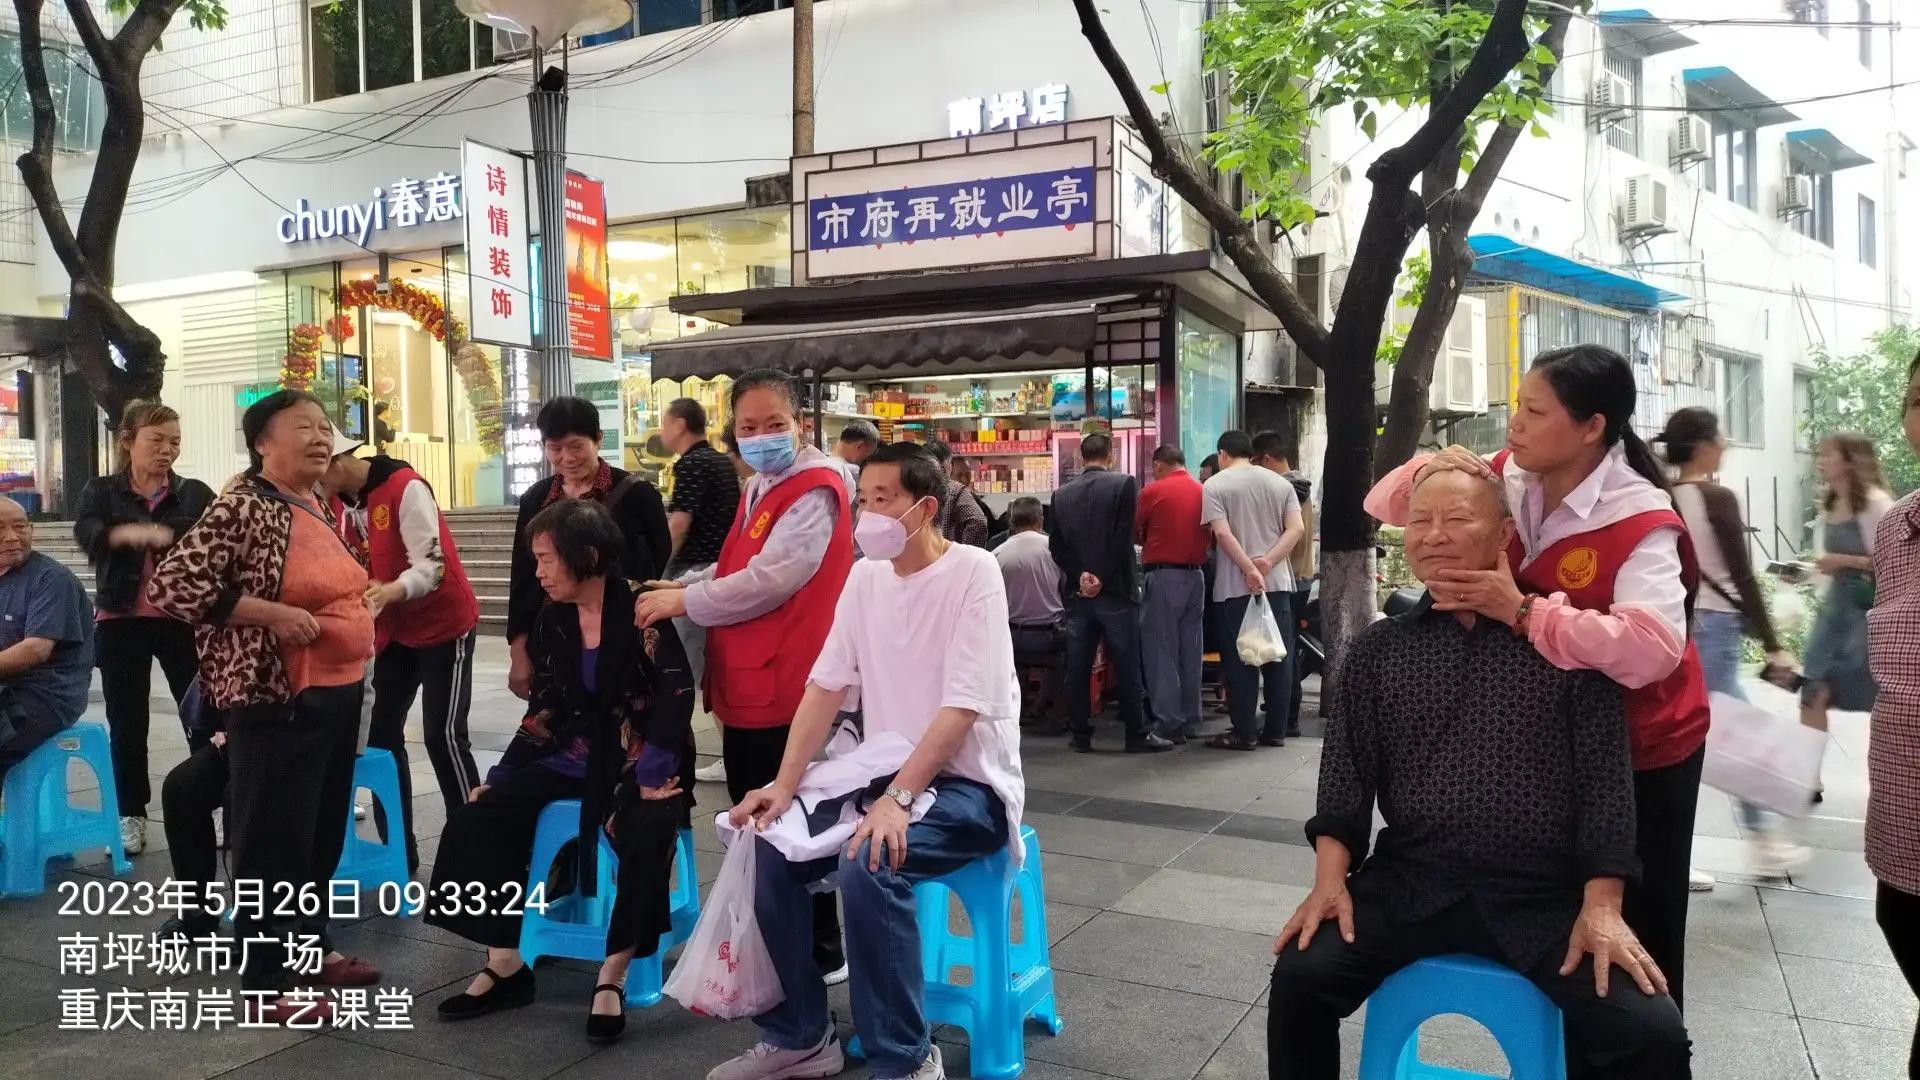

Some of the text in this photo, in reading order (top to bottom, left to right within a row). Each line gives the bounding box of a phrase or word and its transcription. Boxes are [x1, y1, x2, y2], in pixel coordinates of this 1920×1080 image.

[948, 81, 1067, 138] 南坪店
[276, 186, 386, 247] chunyi
[485, 163, 512, 319] 诗情装饰
[816, 174, 1089, 244] 市府再就业亭
